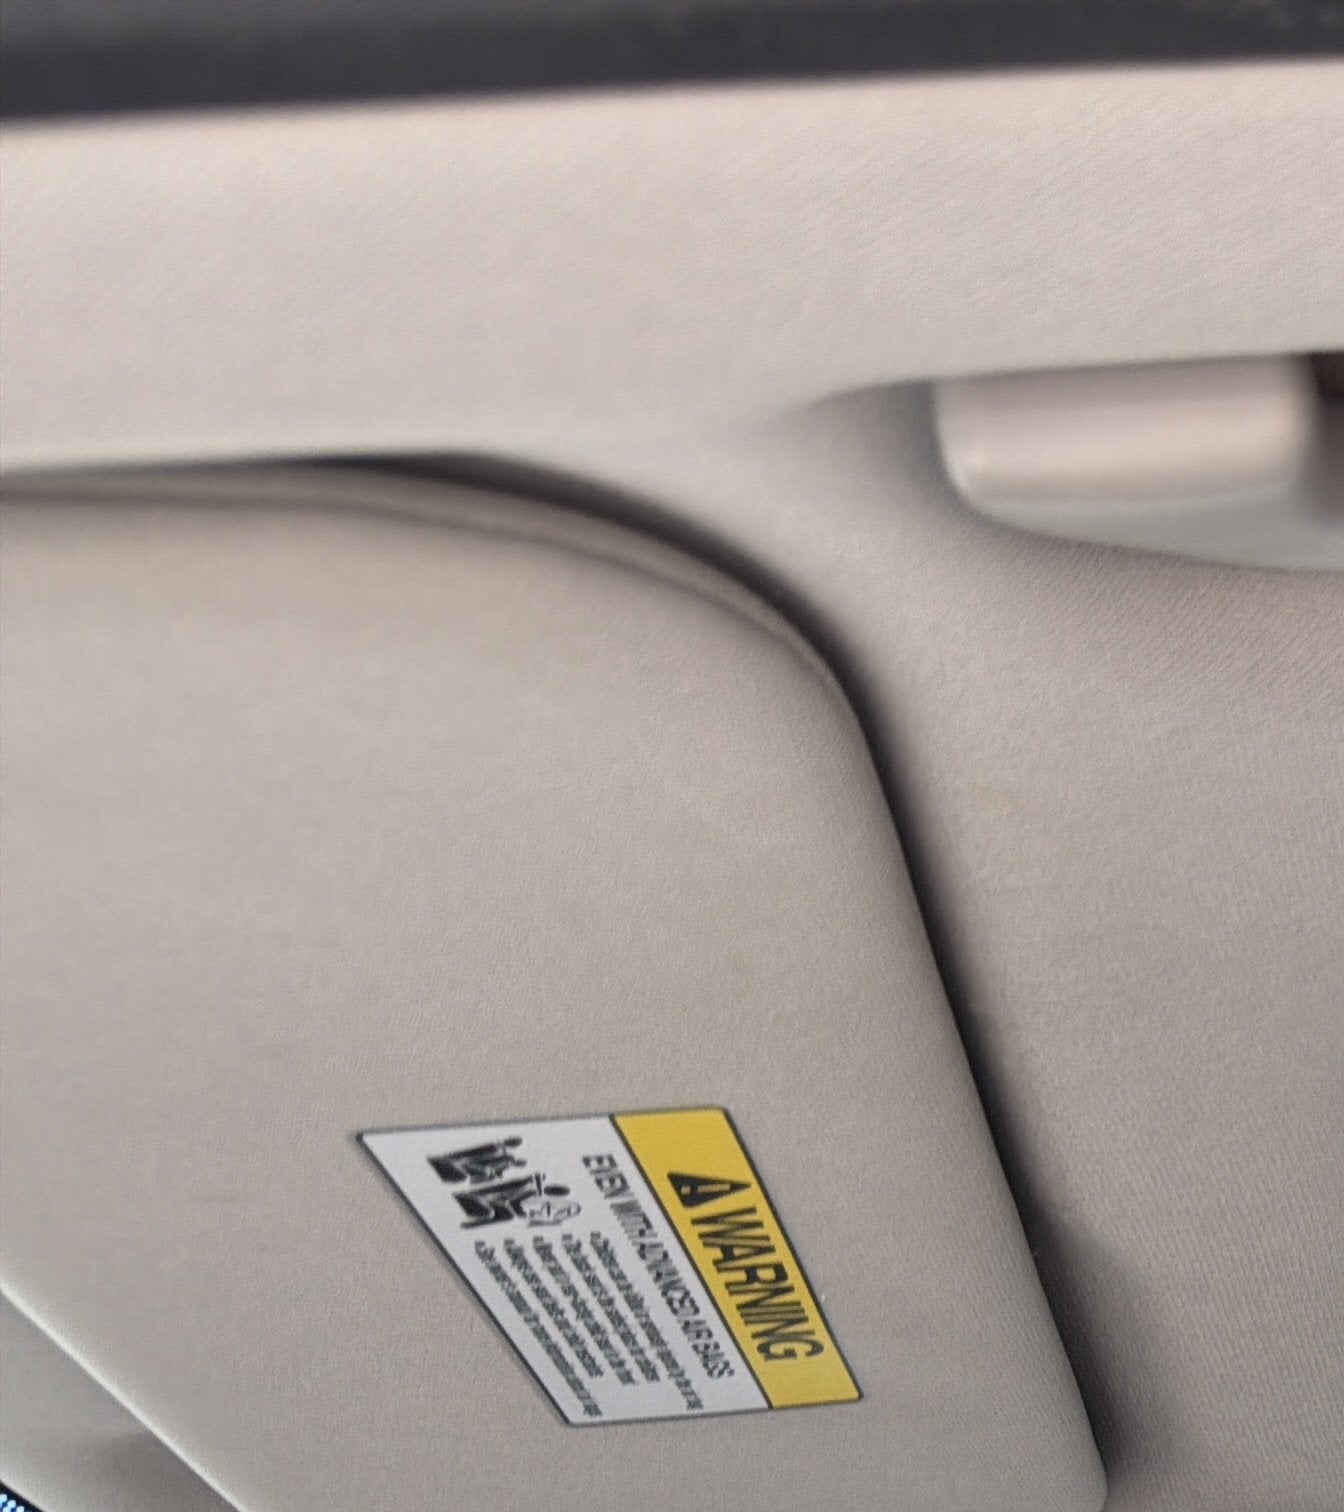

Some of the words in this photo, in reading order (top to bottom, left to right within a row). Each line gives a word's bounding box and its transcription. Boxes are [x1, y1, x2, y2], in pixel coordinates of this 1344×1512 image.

[582, 1154, 635, 1199] EVEN
[610, 1201, 659, 1241] WITH
[632, 1241, 700, 1316] ADVANCED
[690, 1206, 825, 1361] WARNING
[677, 1318, 714, 1342] AIR
[690, 1341, 736, 1378] BAGS
